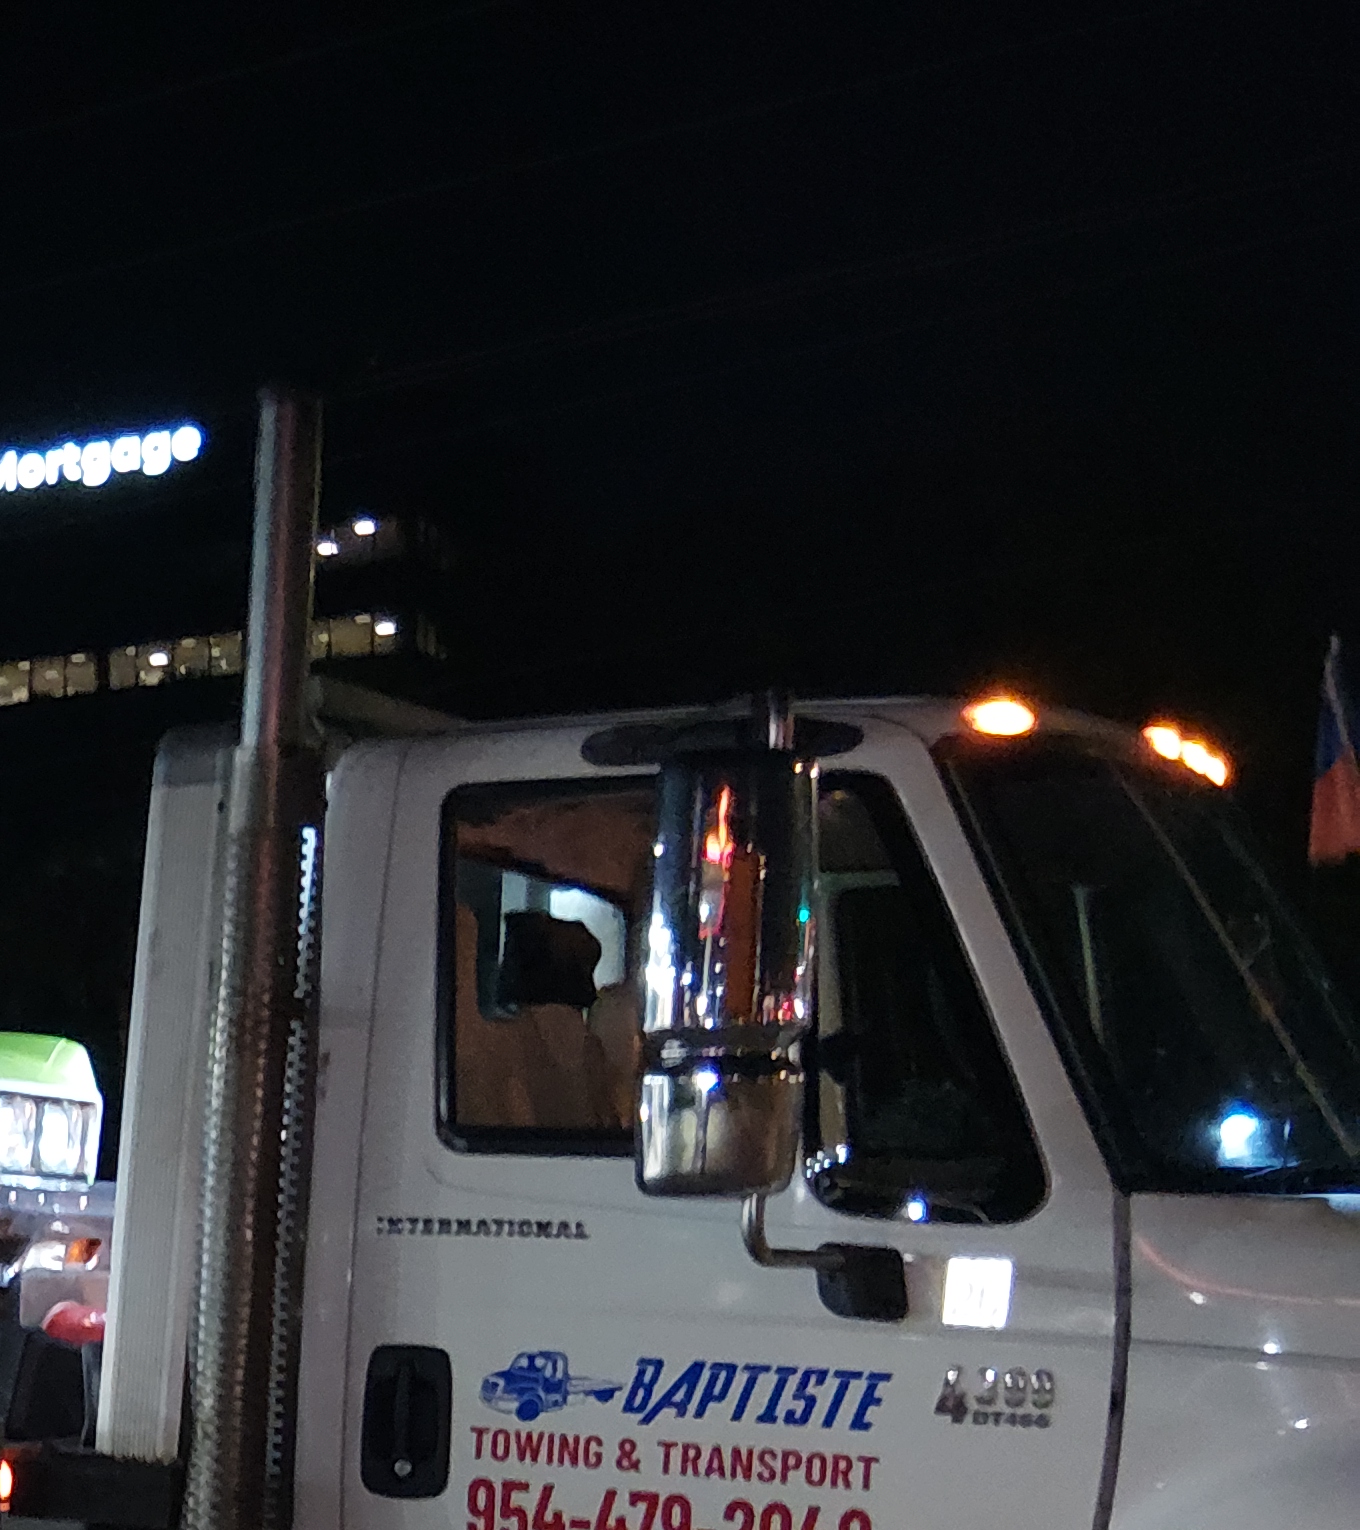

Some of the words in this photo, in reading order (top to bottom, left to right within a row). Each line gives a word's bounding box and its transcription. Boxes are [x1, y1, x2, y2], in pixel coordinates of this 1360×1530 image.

[376, 1216, 590, 1240] INTERNATIONAL
[621, 1357, 893, 1432] BAPTISTE
[470, 1425, 604, 1470] TOWING
[615, 1437, 641, 1473] &
[656, 1439, 881, 1491] TRANSPORT
